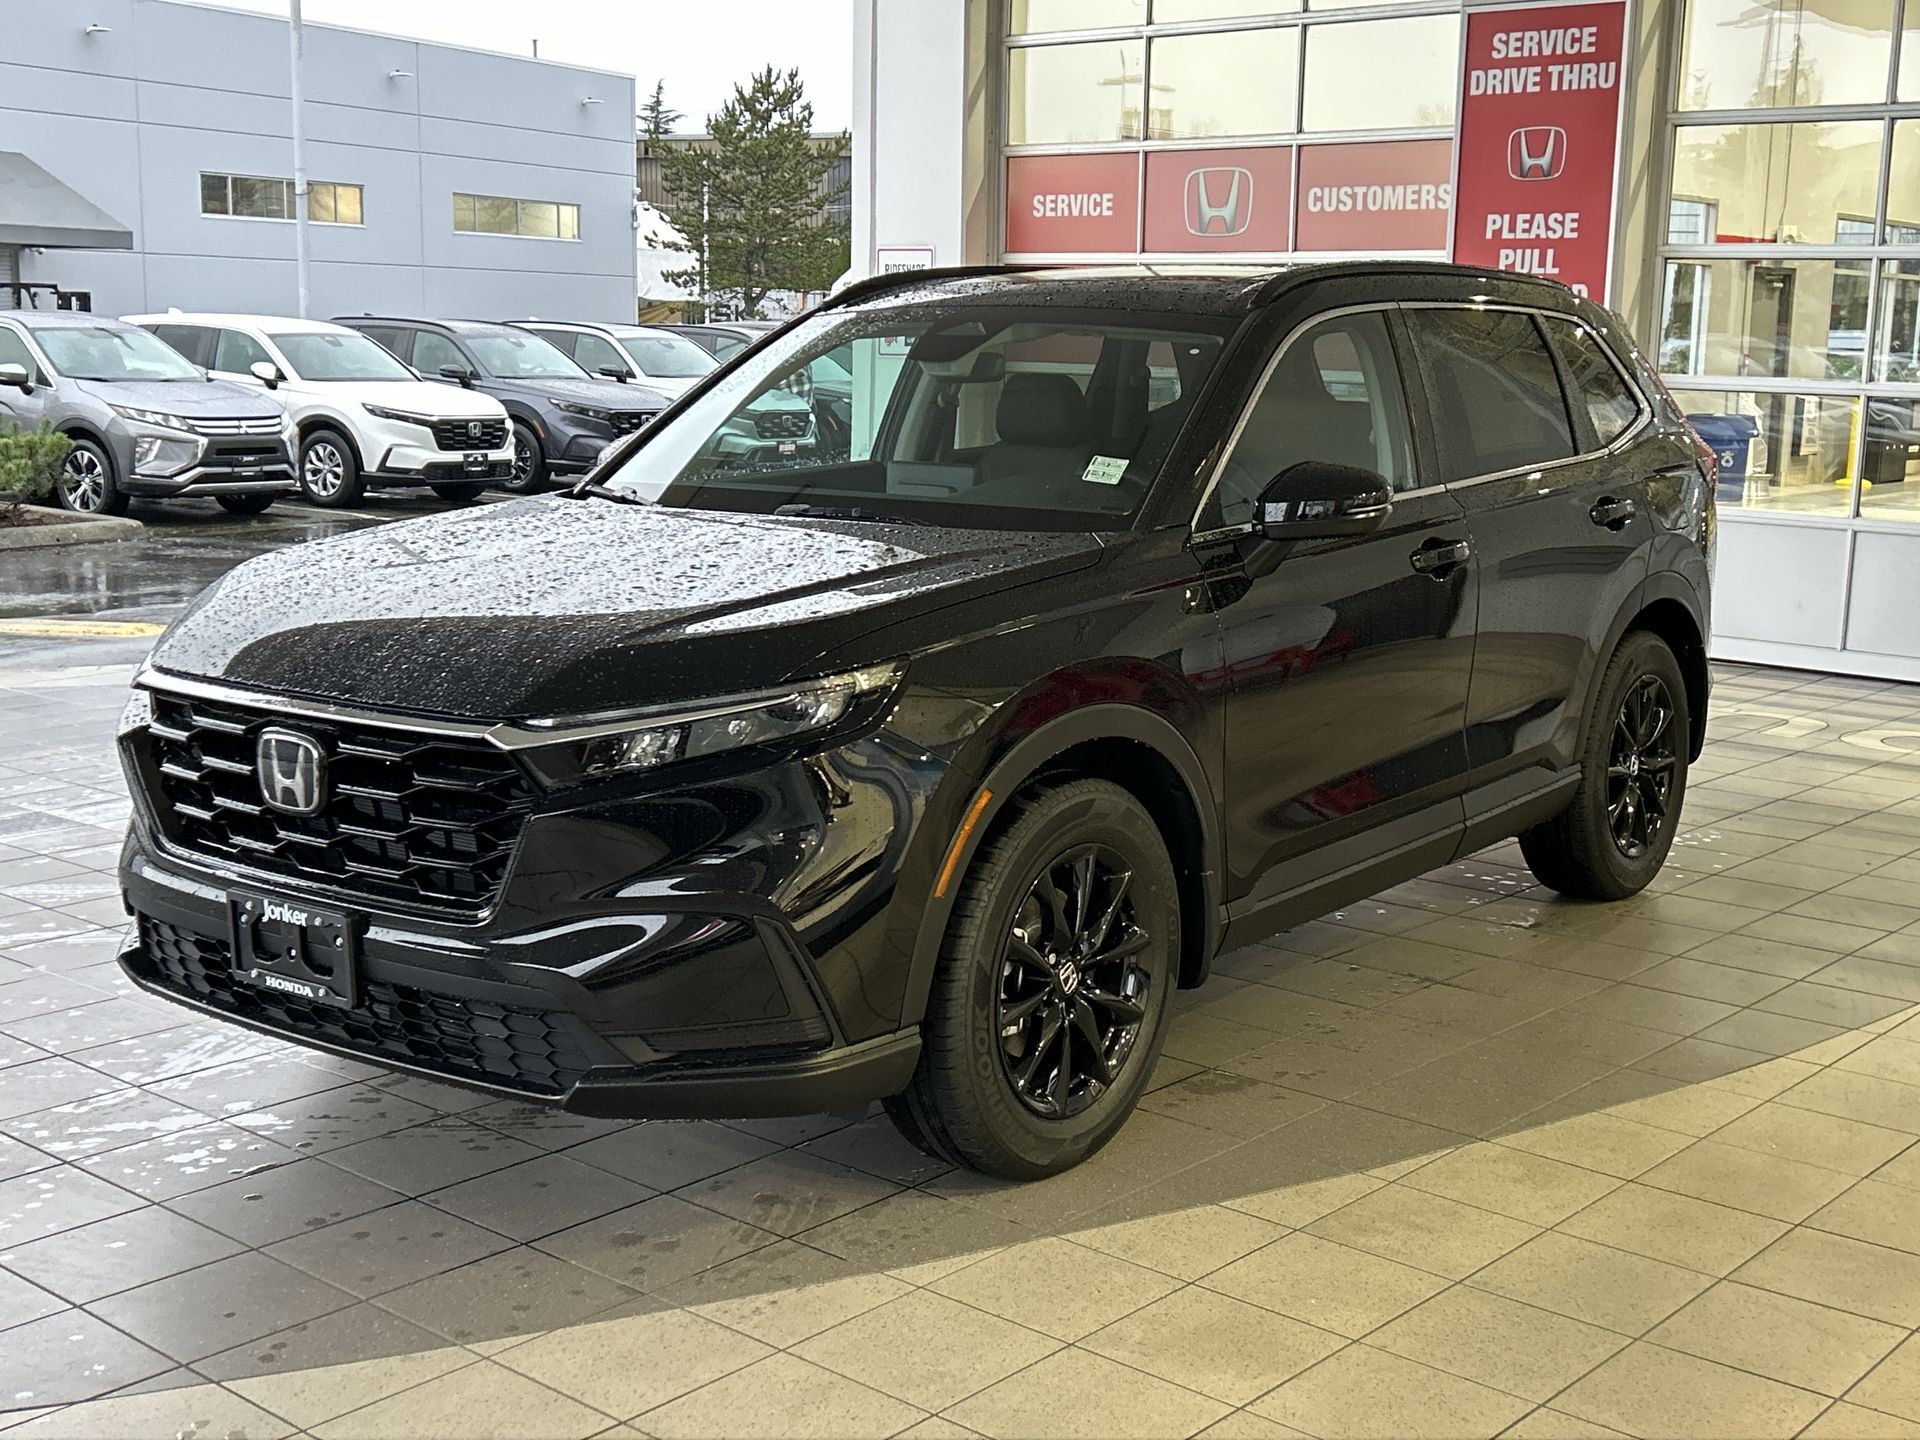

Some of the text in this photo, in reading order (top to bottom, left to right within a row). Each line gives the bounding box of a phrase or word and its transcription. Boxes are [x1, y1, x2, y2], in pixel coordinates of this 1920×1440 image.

[1491, 26, 1598, 59] SERVICE
[1469, 61, 1617, 96] DRIVE THRU
[1032, 193, 1114, 218] SERVICE
[1307, 183, 1452, 213] CUSTOMERS
[1485, 212, 1580, 240] PLEASE
[1498, 248, 1560, 275] PULL
[261, 899, 308, 927] Jonker
[264, 975, 315, 998] HONDA
